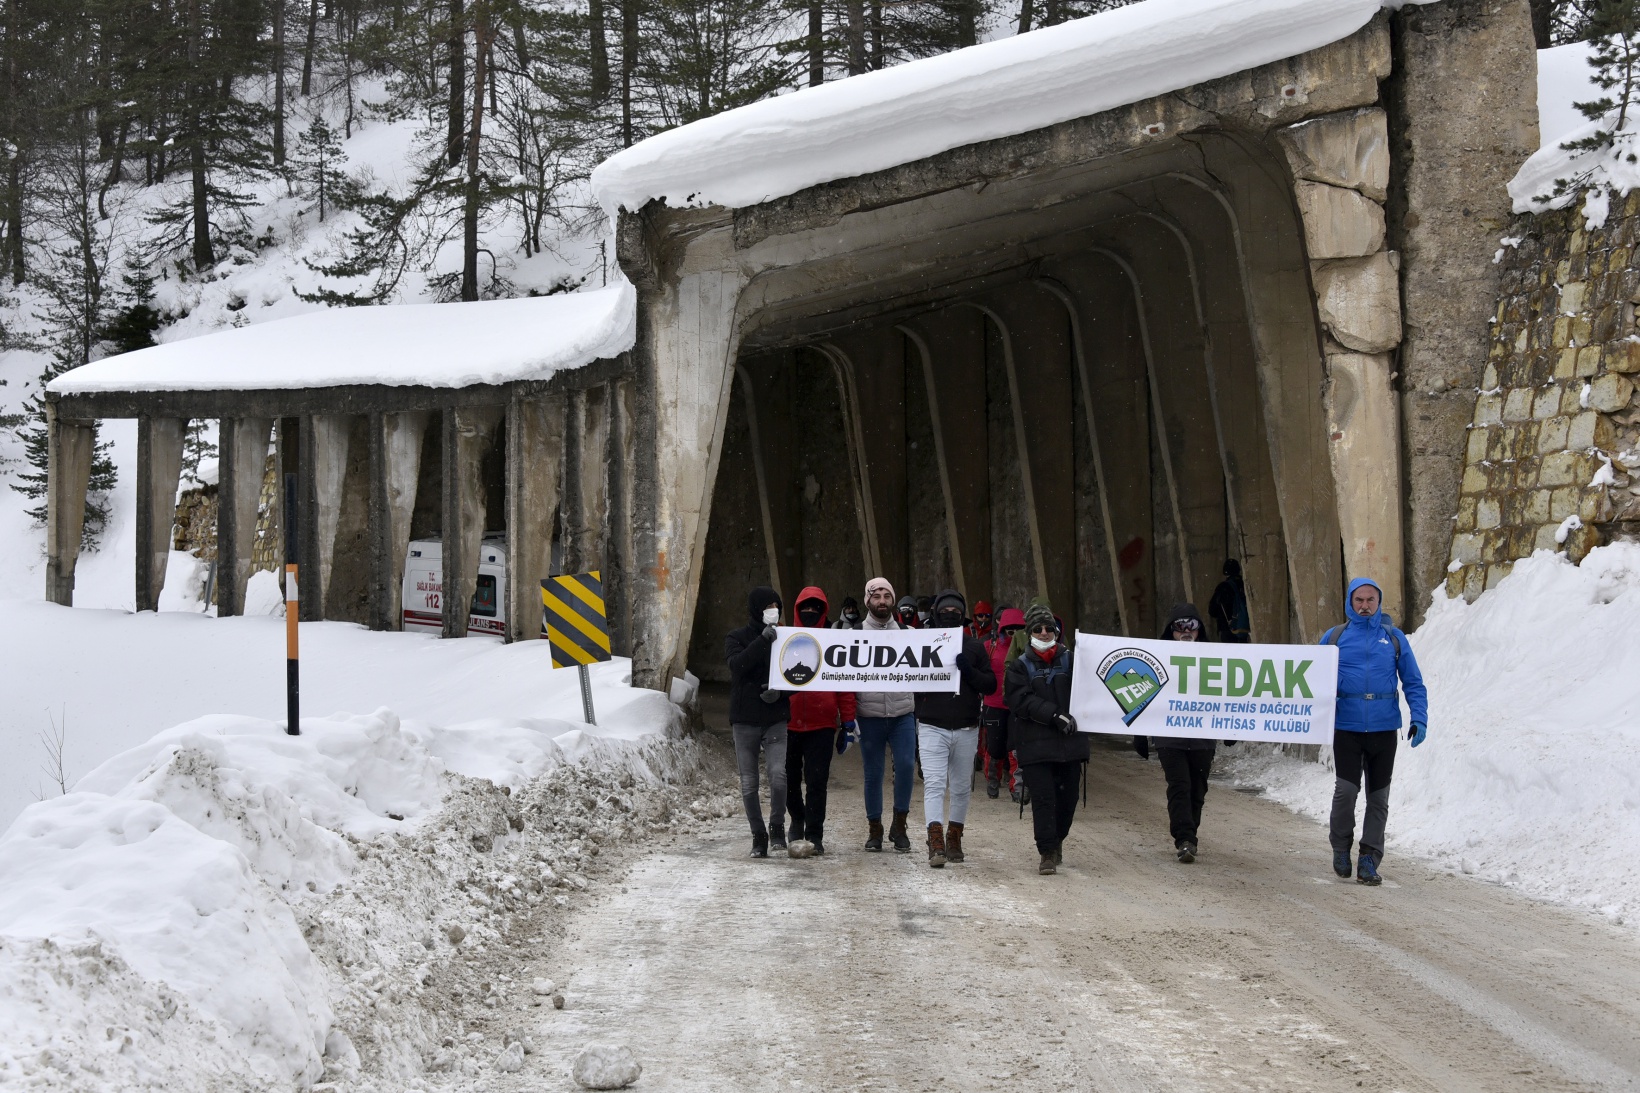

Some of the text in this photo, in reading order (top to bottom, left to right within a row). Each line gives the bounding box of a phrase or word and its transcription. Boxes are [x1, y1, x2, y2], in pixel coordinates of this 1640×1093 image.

[425, 593, 439, 608] 112
[469, 618, 489, 628] ULANS
[824, 639, 944, 668] GÜDAK
[821, 672, 855, 683] Gümüşhane
[856, 673, 880, 683] Dağcılık
[888, 673, 904, 683] Doğa
[904, 673, 929, 683] Sporları
[929, 672, 951, 682] Kulübü
[1169, 655, 1314, 698] TEDAK
[1114, 680, 1154, 704] TEDAK
[1168, 699, 1313, 716] TRABZON TENİS DAĞCILIK
[1165, 715, 1311, 733] KAYAK İHTİSAS KULÜBÜ
